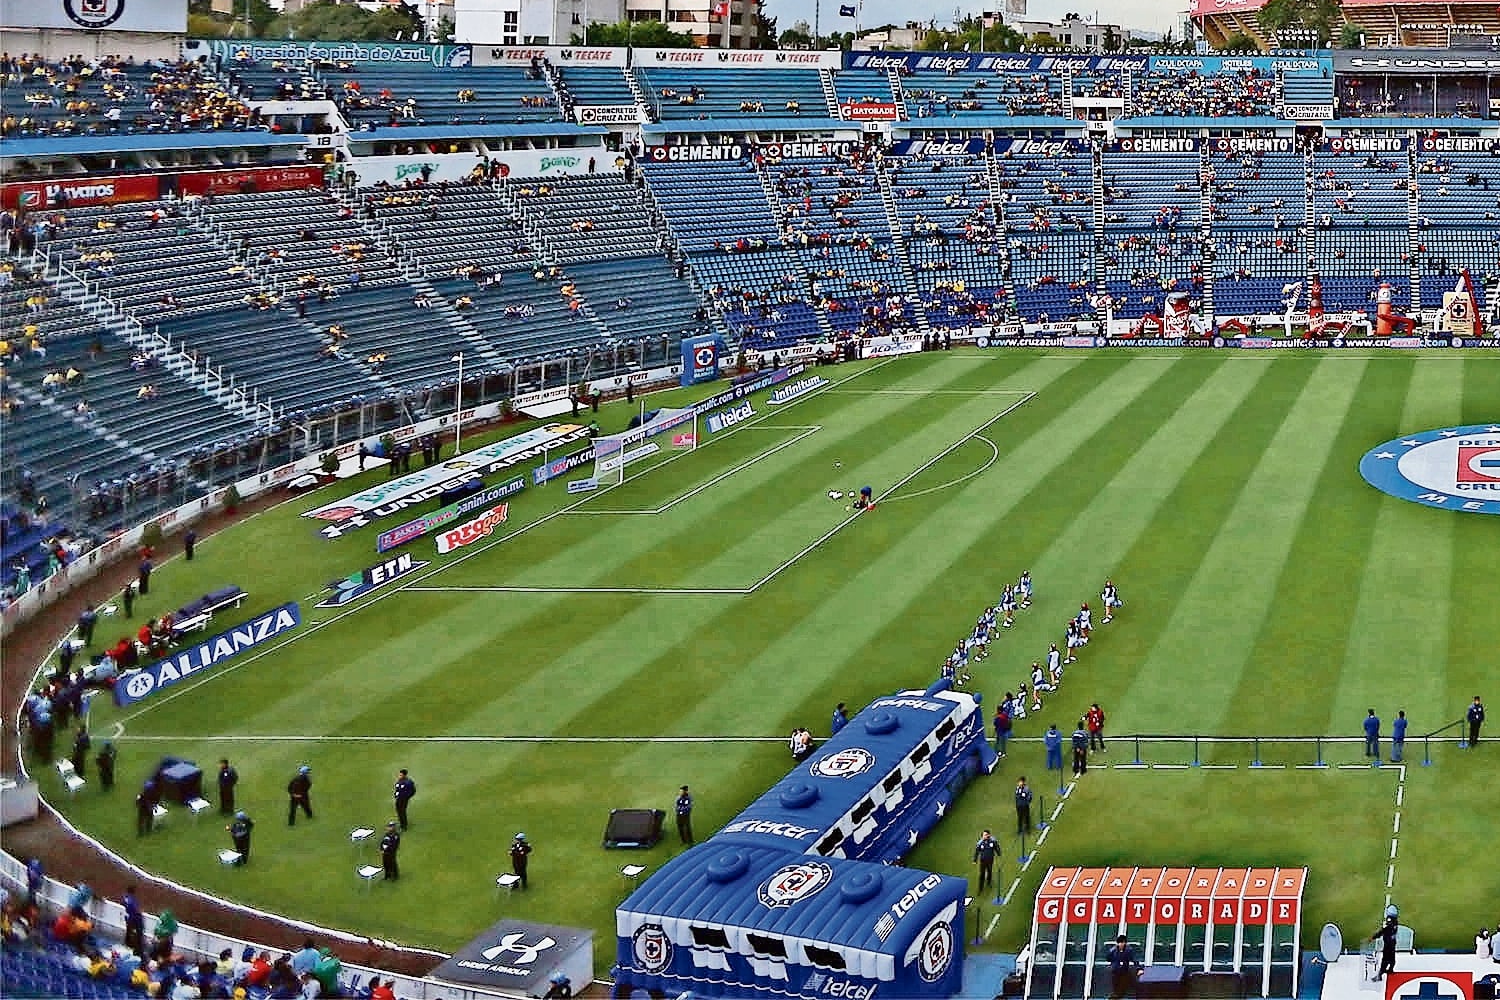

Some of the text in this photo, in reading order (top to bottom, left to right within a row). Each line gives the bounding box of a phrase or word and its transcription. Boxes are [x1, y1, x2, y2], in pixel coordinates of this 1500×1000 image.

[254, 42, 308, 63] pasión
[310, 43, 328, 59] se
[330, 43, 369, 63] pinta
[369, 45, 389, 60] de
[506, 49, 545, 60] TECATE
[573, 50, 612, 61] TECATE
[668, 52, 704, 63] TECATE
[729, 52, 764, 63] TECATE
[784, 53, 821, 63] TECATE
[867, 55, 908, 68] telcel
[929, 55, 968, 69] telcel
[991, 57, 1030, 69] telcel
[1050, 57, 1089, 70] telcel
[1106, 58, 1145, 71] telcel
[853, 107, 895, 115] GATORADE
[924, 141, 968, 154] telcel
[1024, 140, 1068, 153] telcel
[1134, 139, 1194, 152] CEMENTO
[1230, 138, 1289, 151] CEMENTO
[1344, 138, 1401, 151] CEMENTO
[669, 145, 742, 160] CEMENTO
[1109, 339, 1210, 347] www.cruzazulfc.com
[774, 376, 821, 401] infinitum
[721, 402, 758, 427] telcel
[373, 470, 484, 517] UNDER
[371, 553, 413, 586] ETN
[157, 608, 297, 688] ALIANZA
[1051, 876, 1070, 888] G
[891, 872, 942, 919] telcel
[1042, 900, 1290, 919] G GATORADE
[457, 959, 531, 976] UNDER ARMOUR
[822, 977, 879, 1000] telcel
